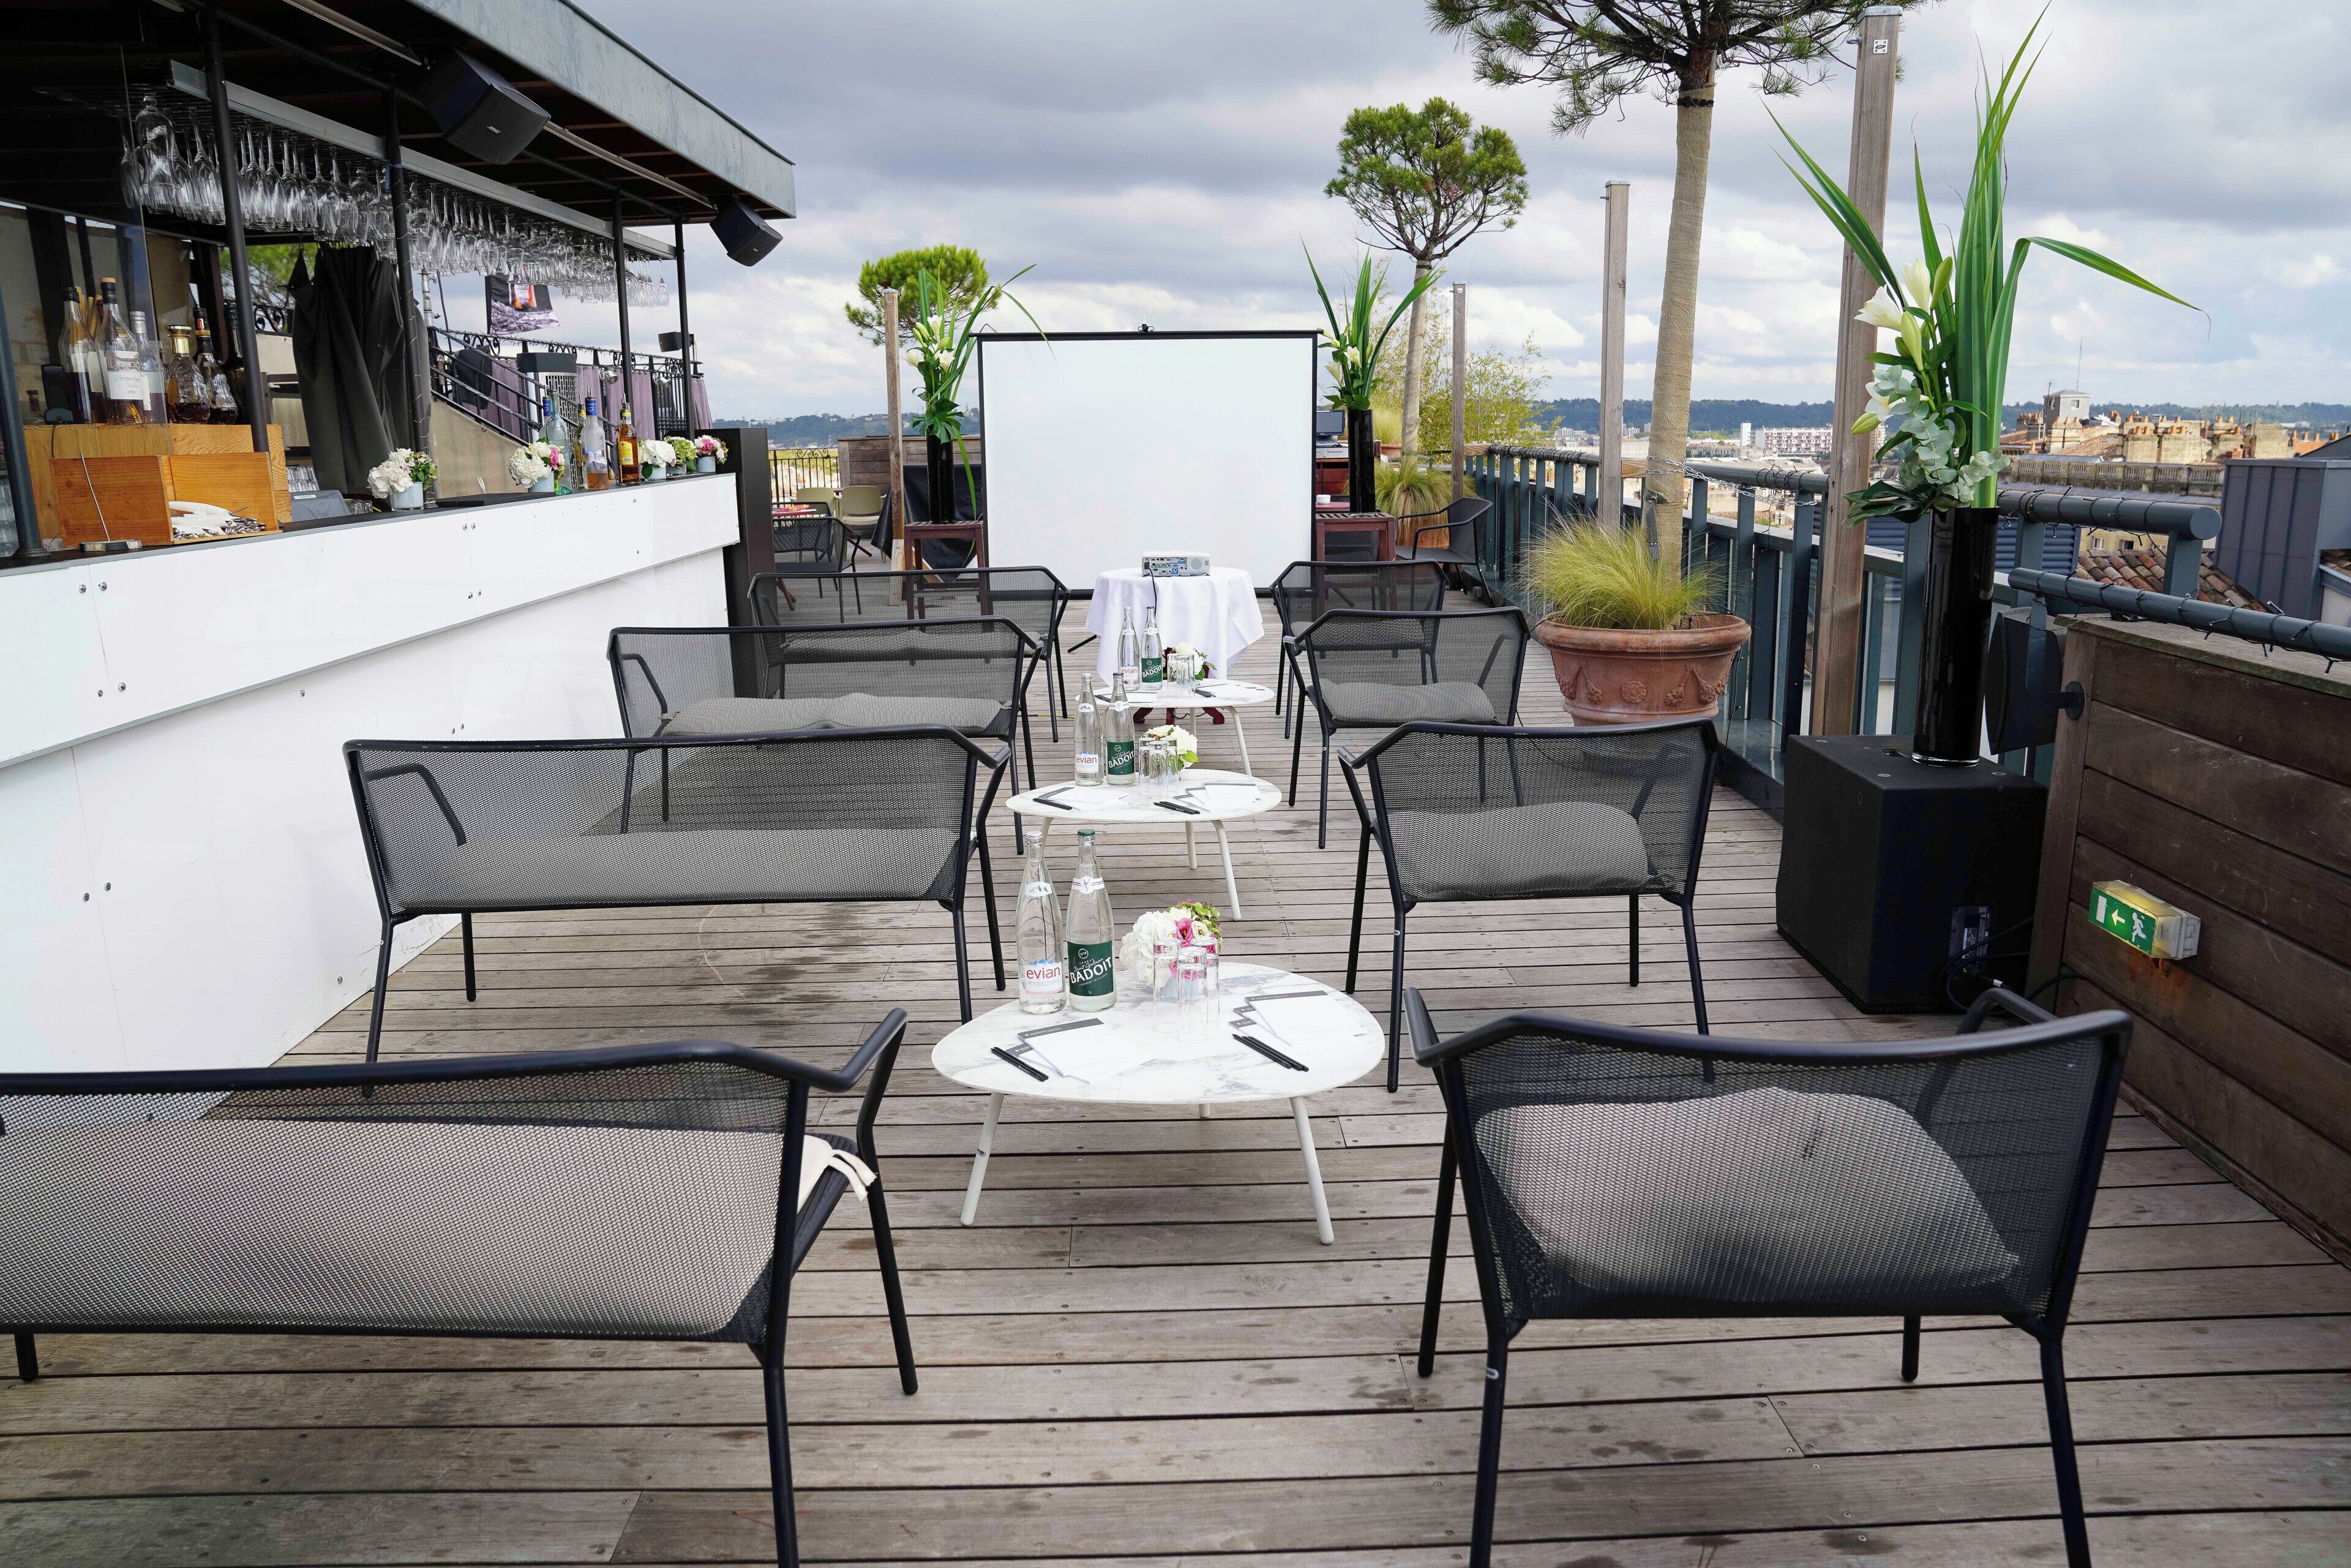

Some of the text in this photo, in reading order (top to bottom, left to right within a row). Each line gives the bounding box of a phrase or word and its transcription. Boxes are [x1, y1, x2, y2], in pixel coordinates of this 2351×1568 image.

[1142, 664, 1161, 678] BADOIT
[1108, 751, 1134, 768] BADOIT
[1026, 967, 1060, 979] evian
[1070, 956, 1111, 983] BADOIT
